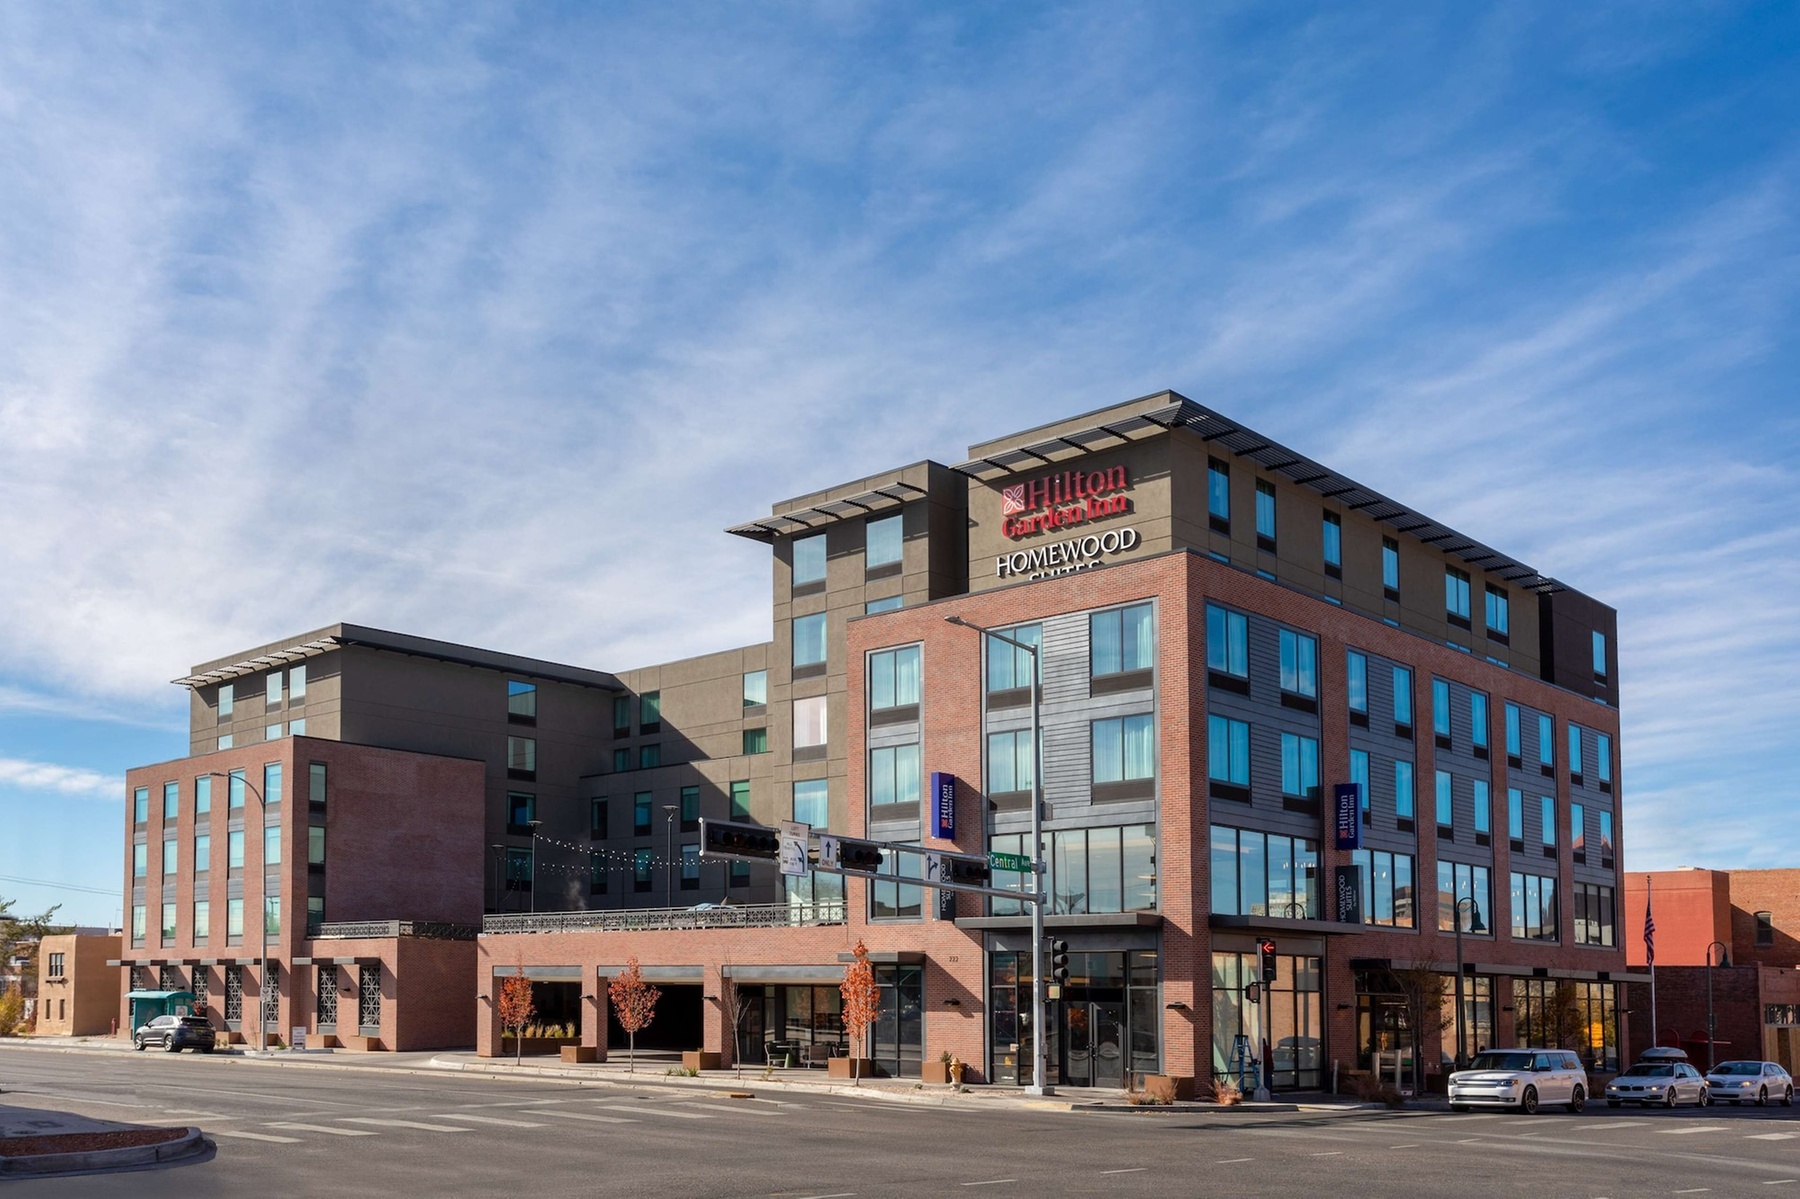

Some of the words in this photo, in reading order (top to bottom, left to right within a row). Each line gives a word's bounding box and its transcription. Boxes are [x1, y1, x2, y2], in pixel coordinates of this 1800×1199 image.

[1028, 464, 1127, 510] Hilton
[1002, 505, 1082, 539] Garden
[1086, 494, 1127, 520] Inn
[996, 527, 1136, 576] HOMEWOOD
[941, 784, 949, 819] Hilton
[1339, 795, 1348, 829] Hilton
[821, 858, 835, 867] ONLY
[990, 854, 1019, 870] Central
[1020, 857, 1031, 867] Ave
